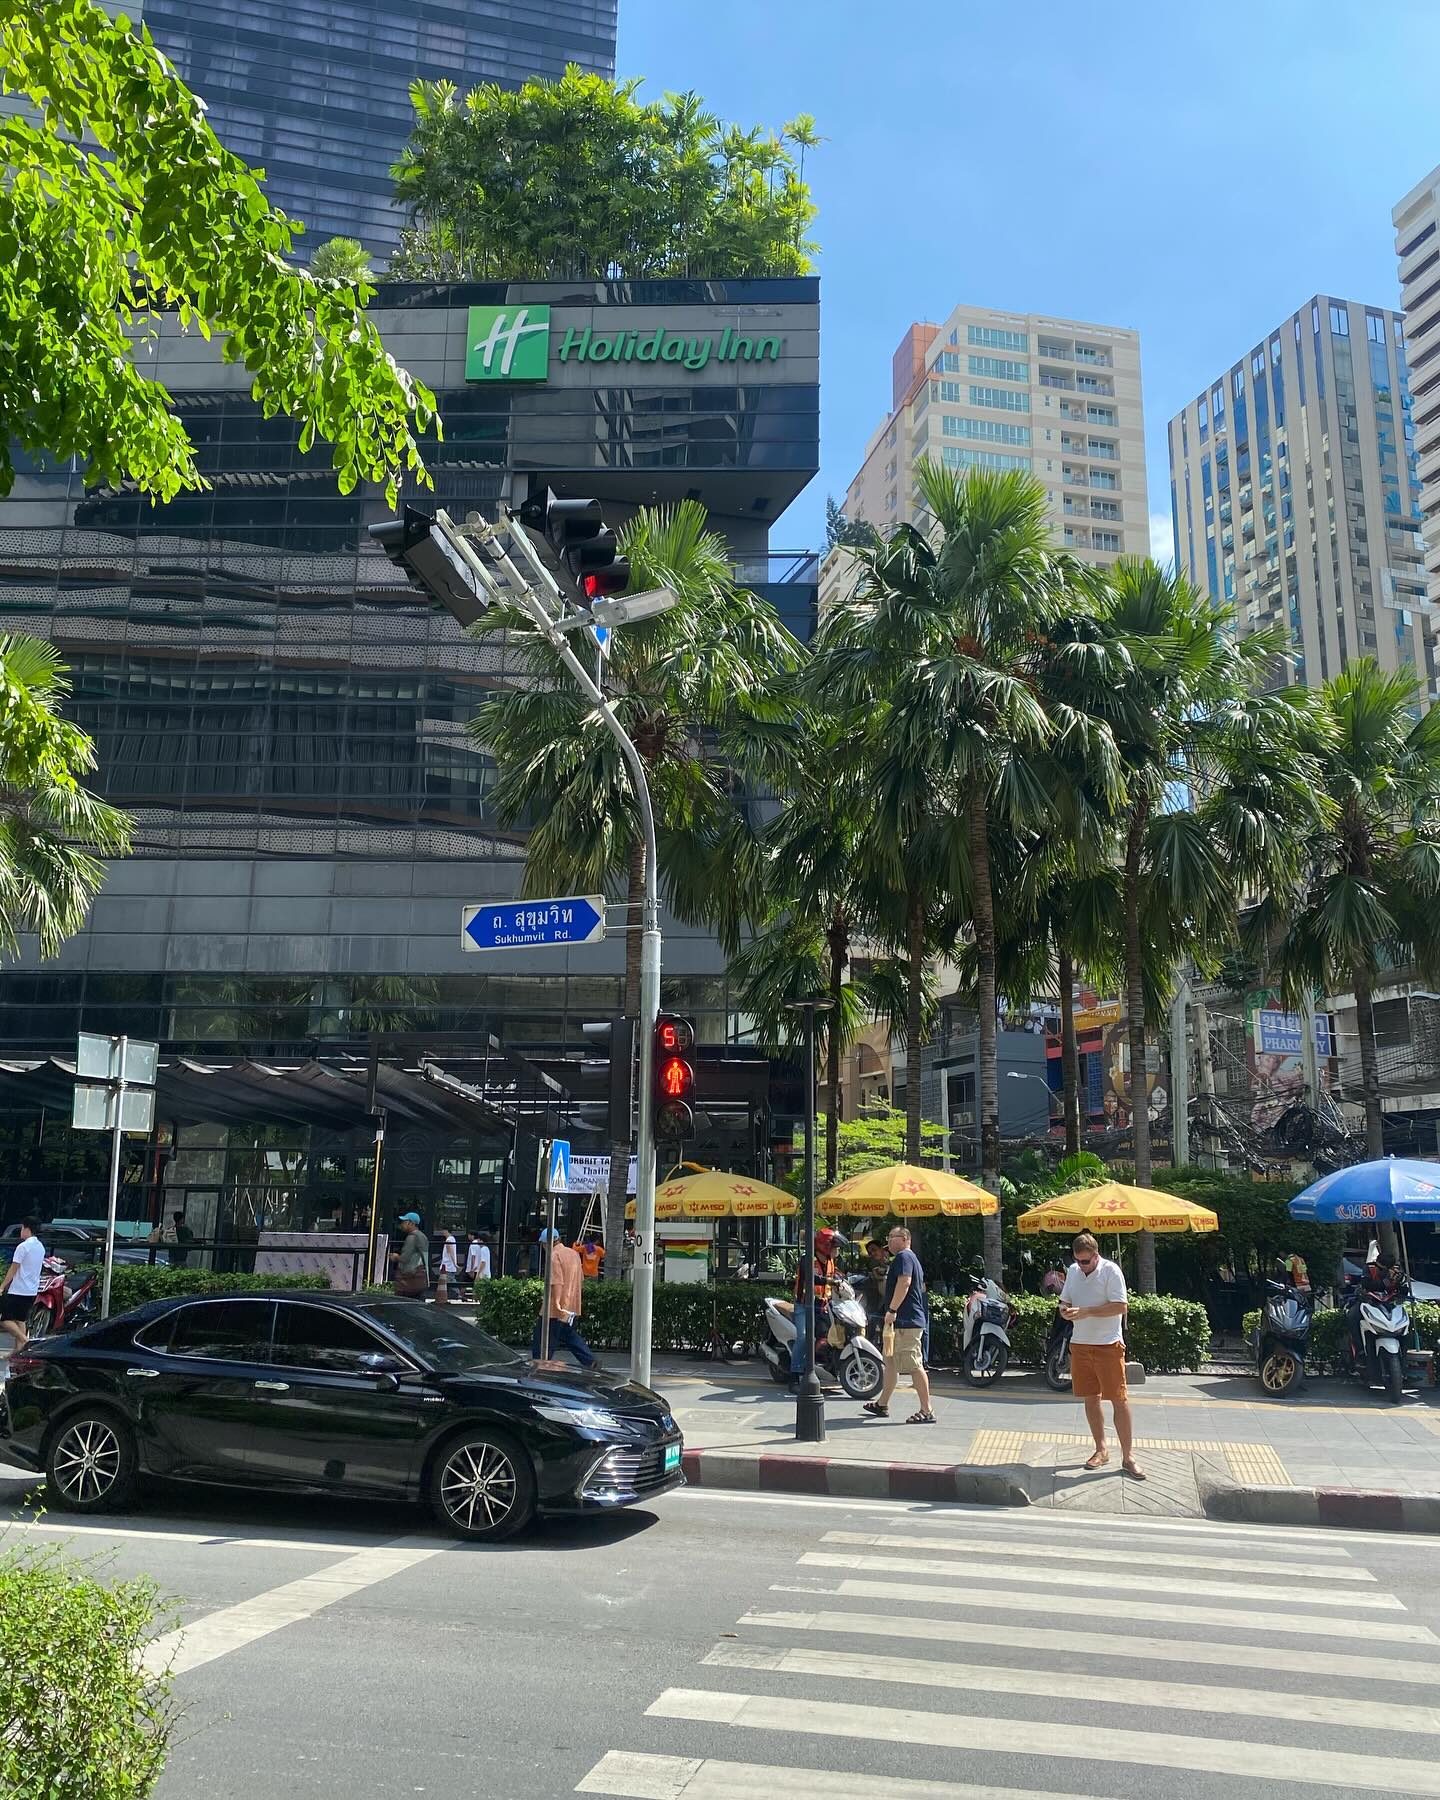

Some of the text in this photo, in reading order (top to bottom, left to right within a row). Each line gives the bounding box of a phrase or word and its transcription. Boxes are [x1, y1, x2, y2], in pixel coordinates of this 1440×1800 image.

[558, 326, 781, 369] Holiday Inn
[492, 904, 574, 932] ถ. สุขุมวิท
[494, 930, 572, 945] Sukhumvit Rd.
[1347, 1203, 1377, 1219] 1450
